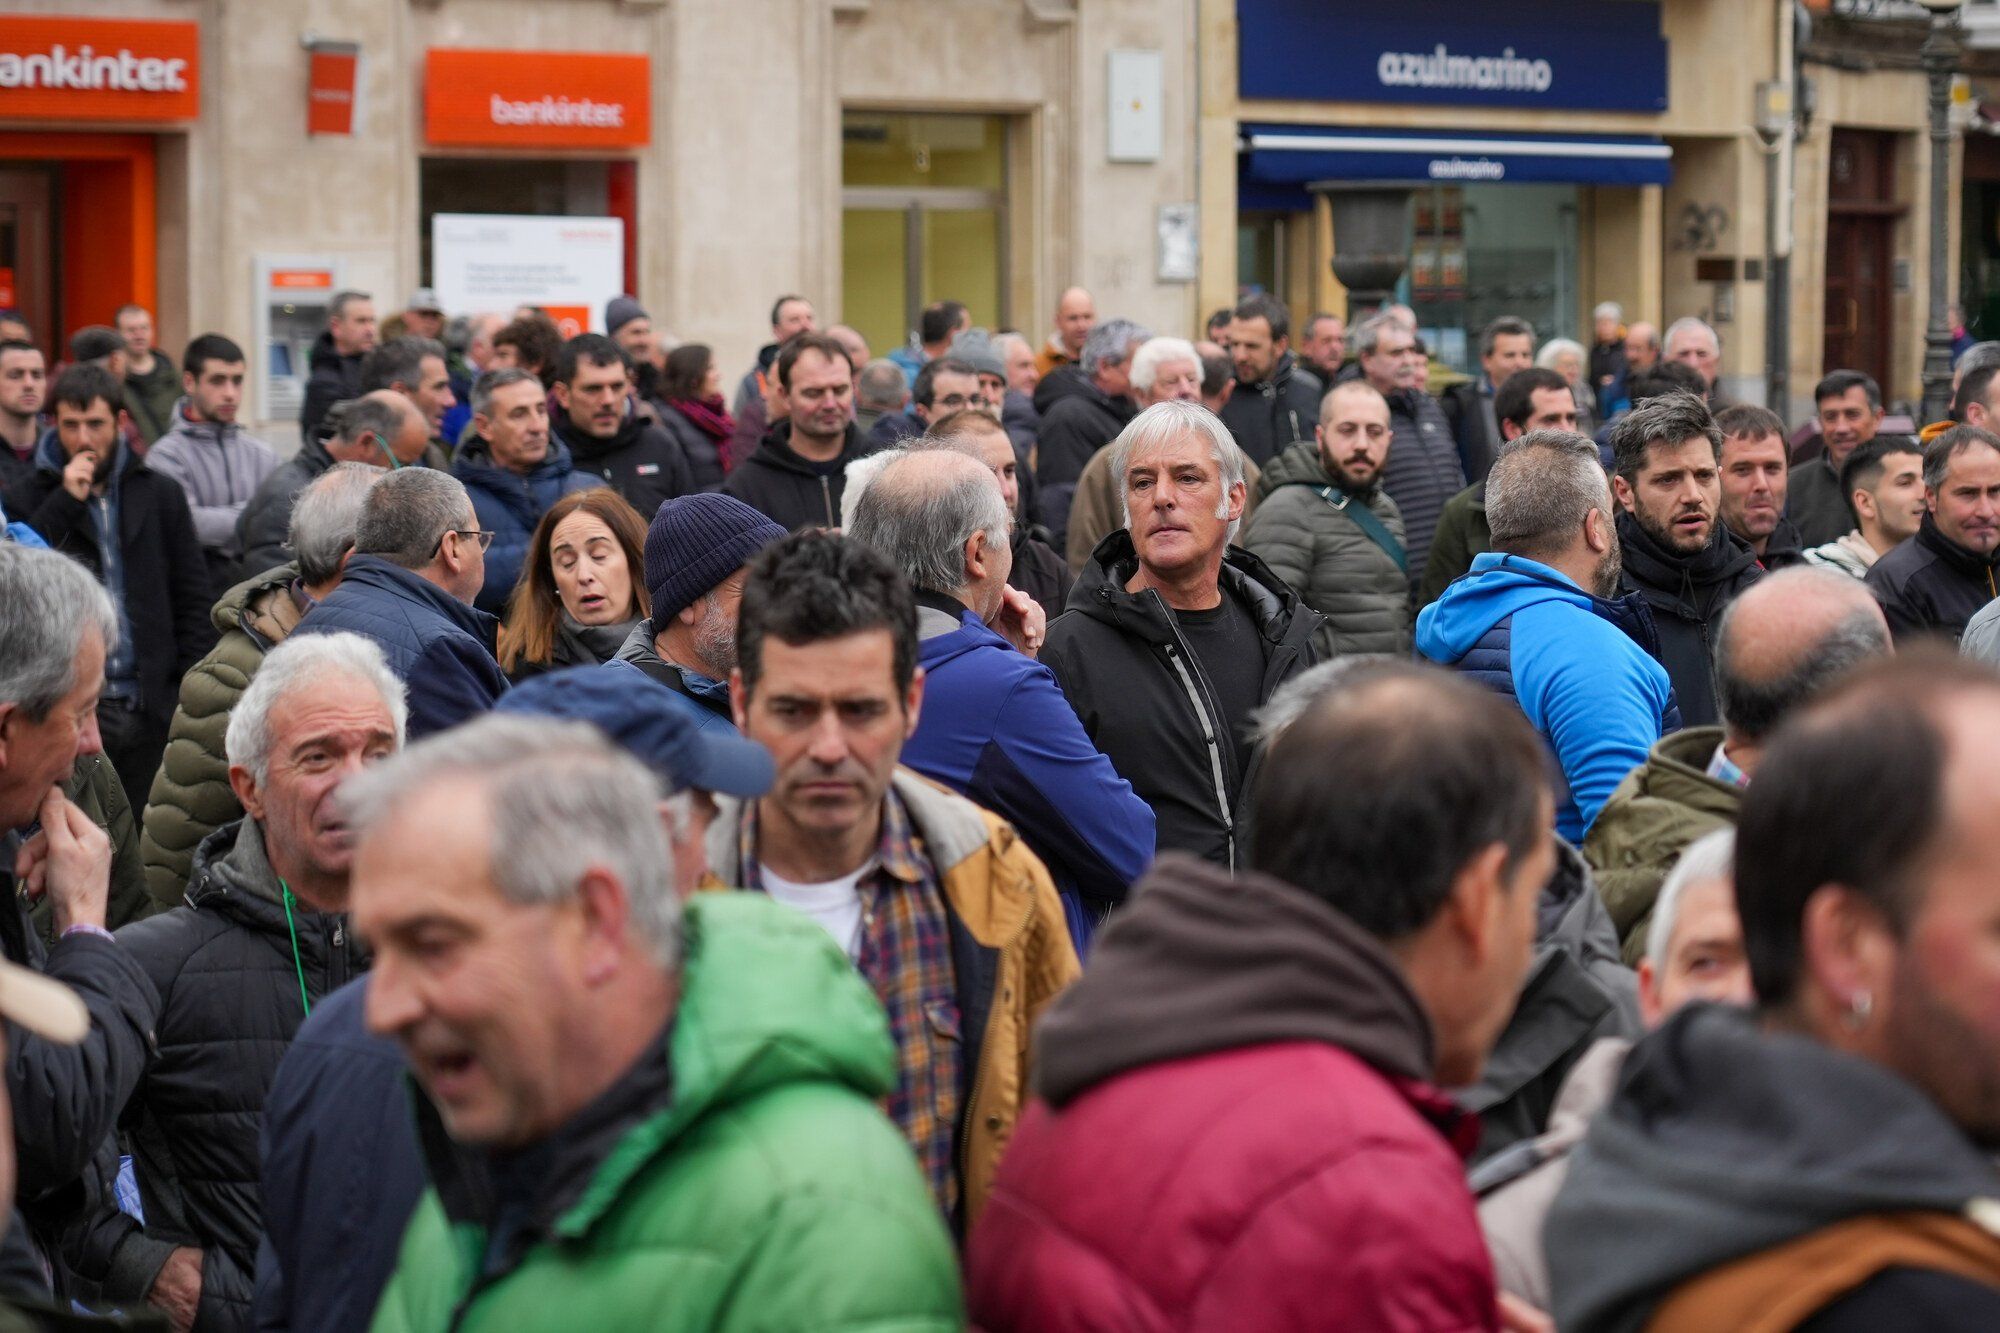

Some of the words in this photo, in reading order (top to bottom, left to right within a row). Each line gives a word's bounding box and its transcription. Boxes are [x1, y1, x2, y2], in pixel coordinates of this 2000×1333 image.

[0, 44, 187, 92] ankinter
[1377, 43, 1552, 93] azulmarino
[1428, 157, 1505, 180] azulmarino
